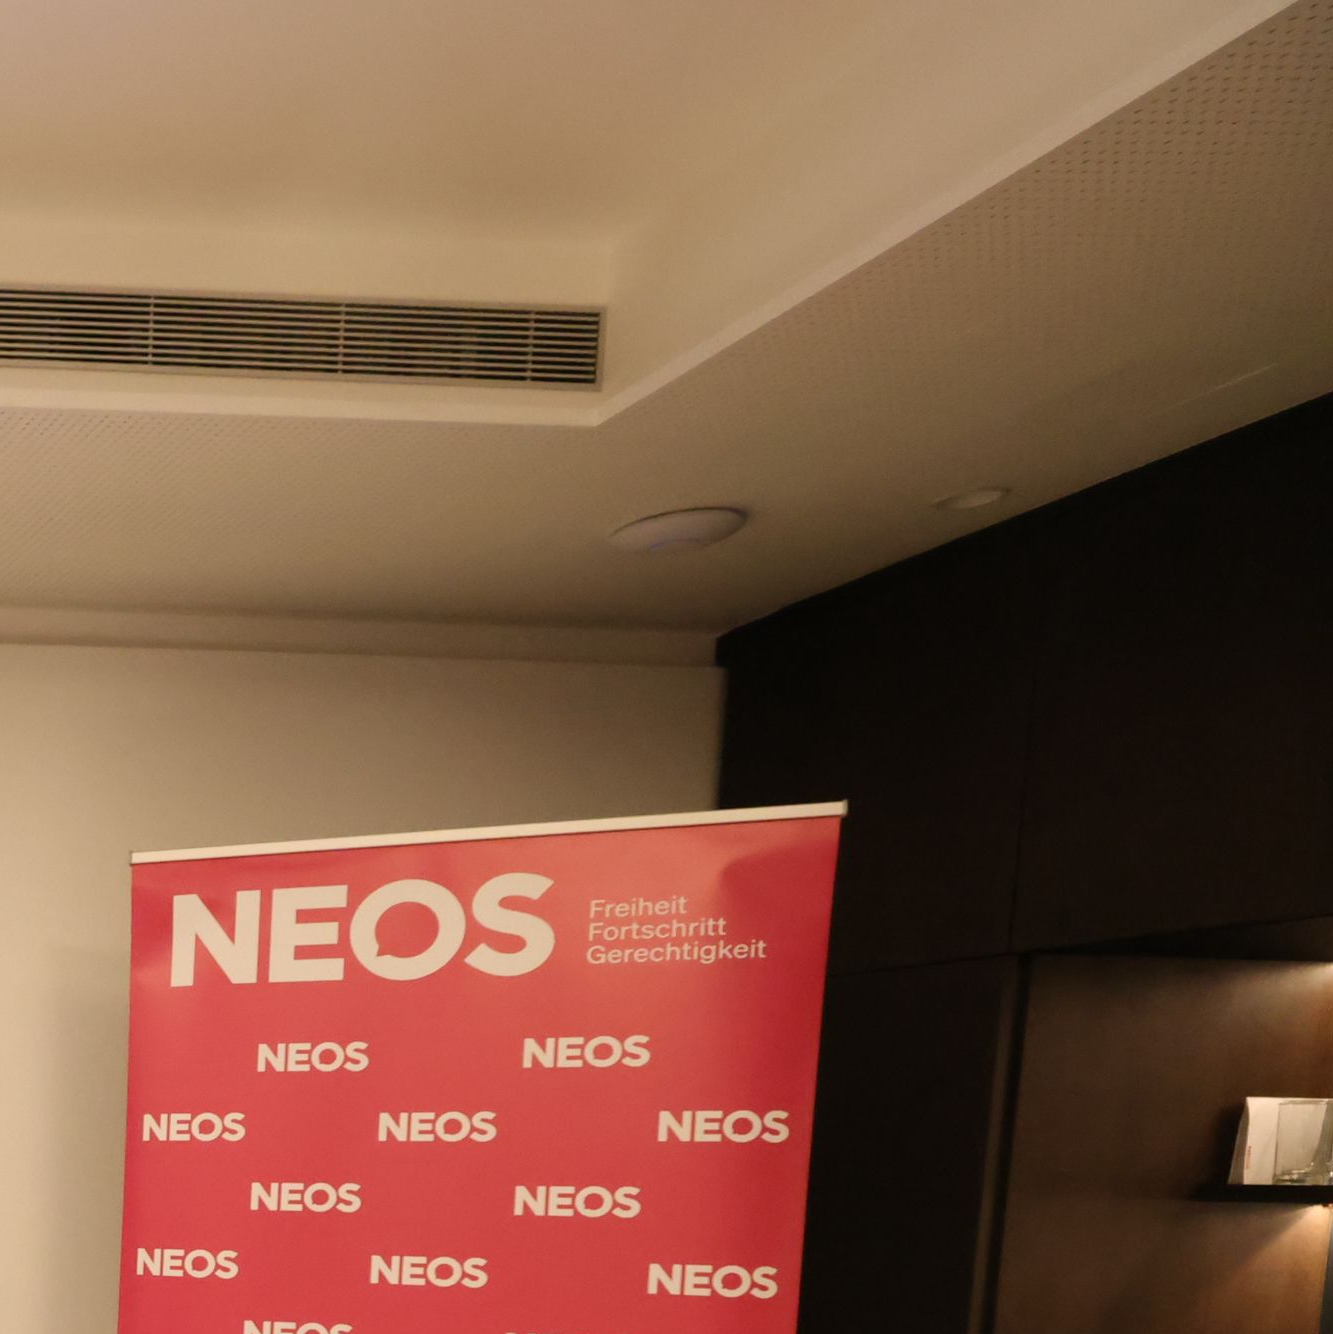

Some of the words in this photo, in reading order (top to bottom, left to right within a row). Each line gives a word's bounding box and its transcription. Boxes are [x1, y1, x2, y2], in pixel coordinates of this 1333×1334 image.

[588, 894, 689, 919] Freiheit
[170, 870, 556, 988] NEOS
[588, 917, 727, 942] Fortschritt
[585, 938, 767, 966] Gerechtigkeit
[257, 1041, 369, 1072] NEOS
[523, 1035, 650, 1068] NEOS
[141, 1112, 246, 1142] NEOS
[378, 1111, 496, 1142] NEOS
[658, 1111, 790, 1143] NEOS
[250, 1182, 362, 1213] NEOS
[514, 1186, 641, 1218] NEOS
[136, 1248, 239, 1279] NEOS
[370, 1255, 488, 1288] NEOS
[647, 1264, 779, 1299] NEOS
